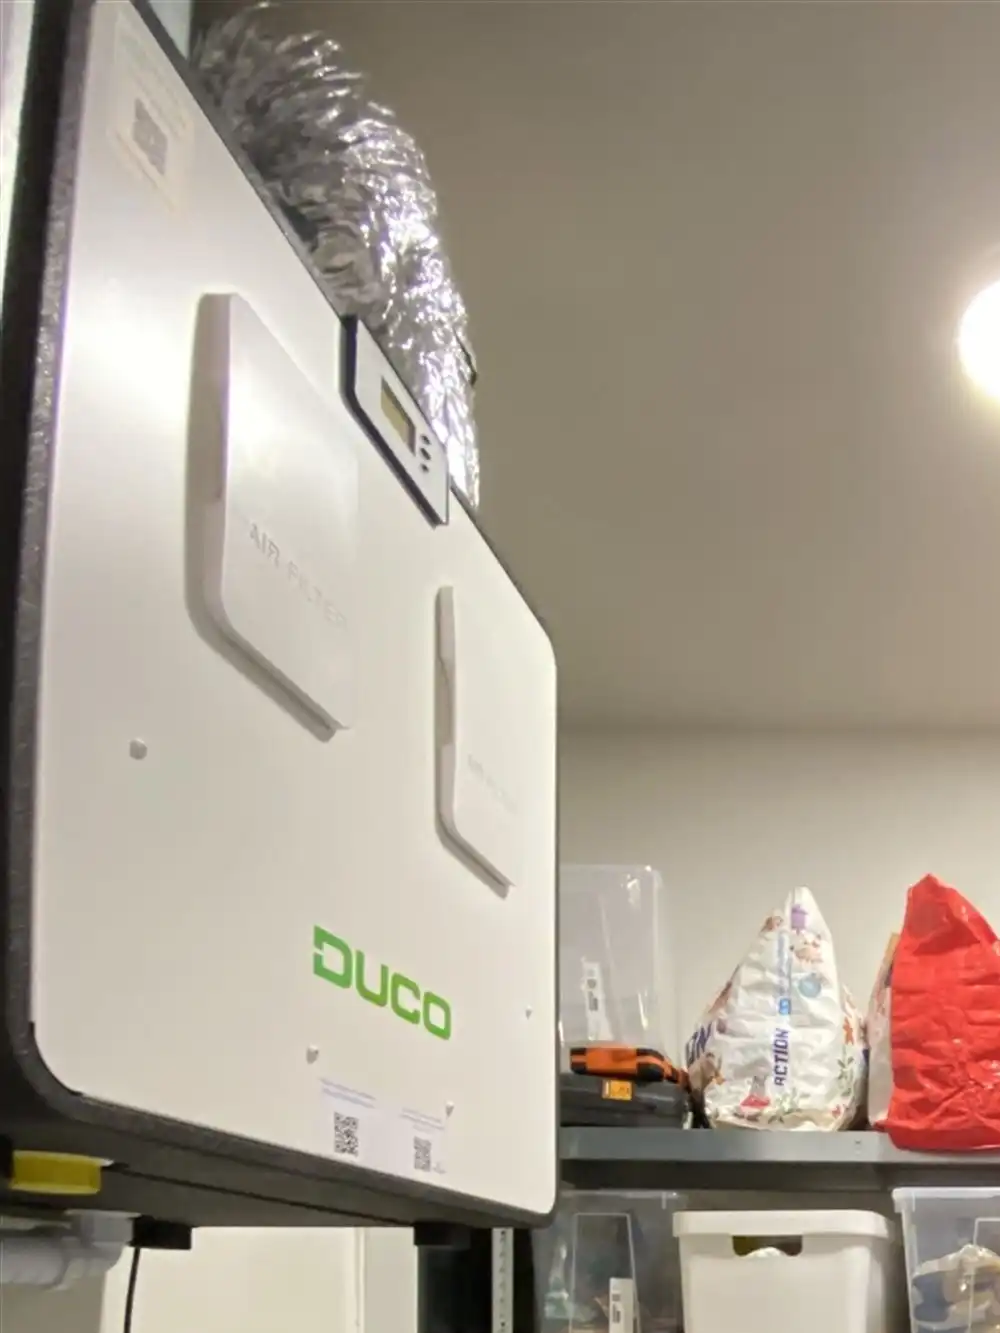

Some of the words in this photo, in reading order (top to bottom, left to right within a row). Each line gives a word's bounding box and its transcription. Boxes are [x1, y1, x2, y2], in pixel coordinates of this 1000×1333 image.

[249, 523, 280, 569] AIR
[313, 924, 451, 1041] DUCO
[773, 1028, 790, 1086] ACTION
